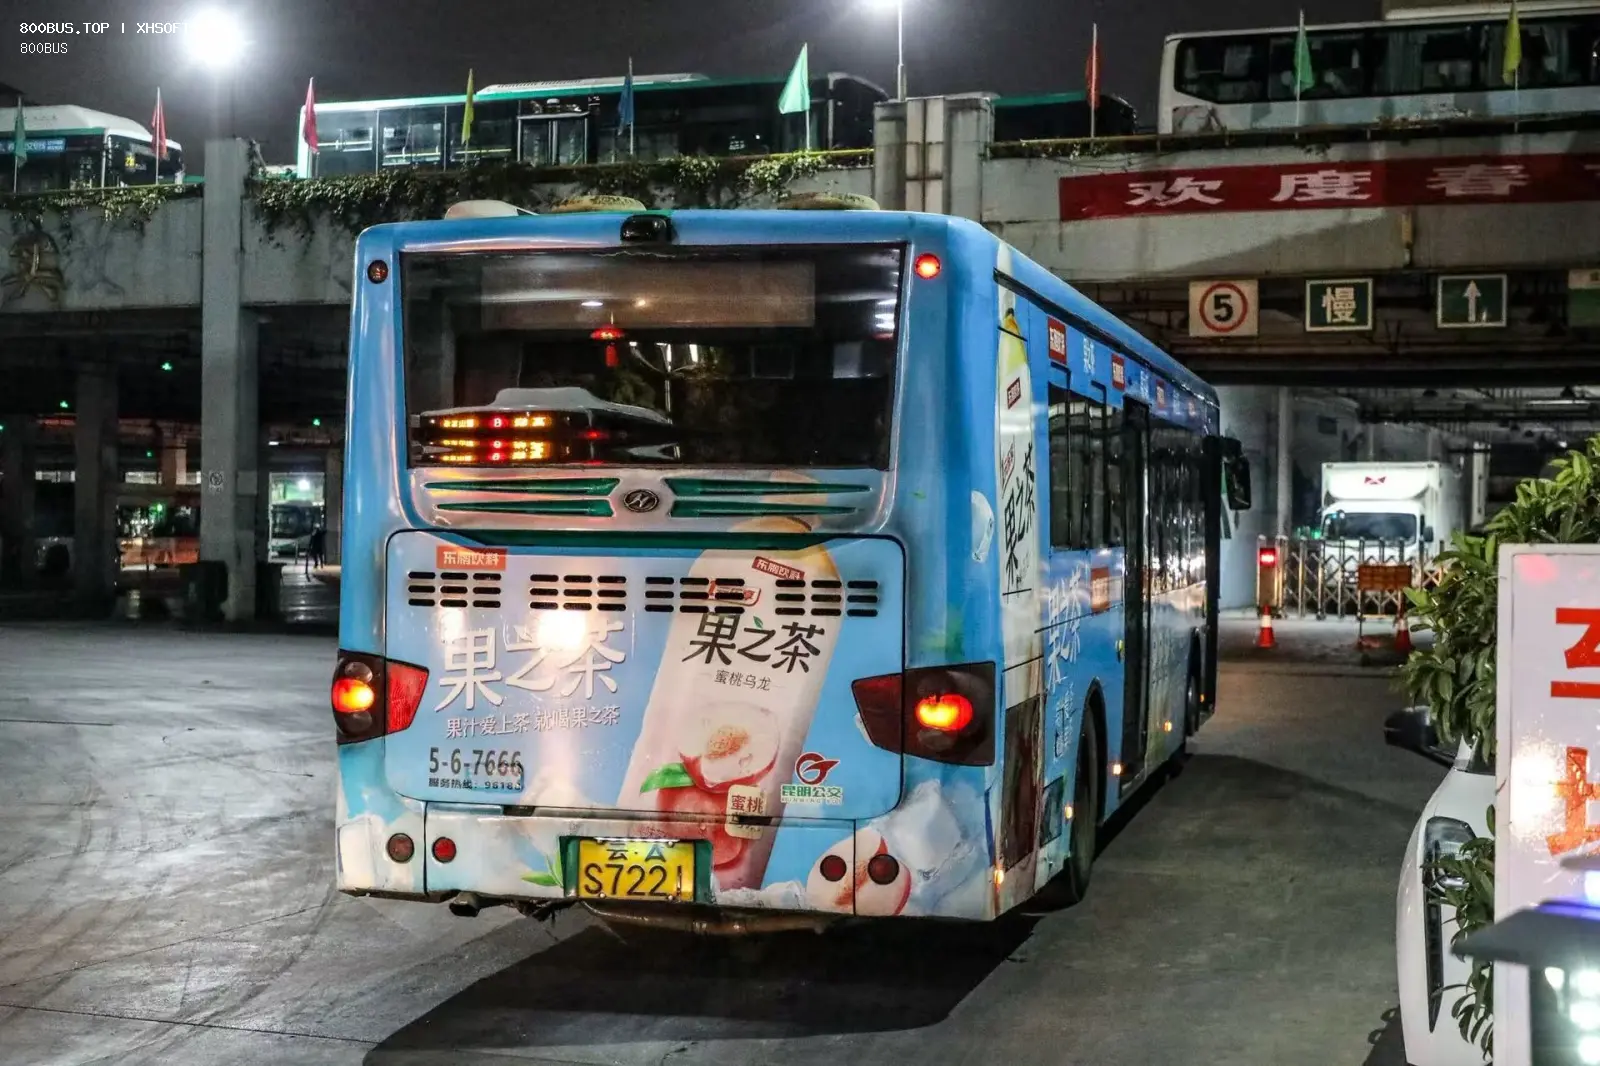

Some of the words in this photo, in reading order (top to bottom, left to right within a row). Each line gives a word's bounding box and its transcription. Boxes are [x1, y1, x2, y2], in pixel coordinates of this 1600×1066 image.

[1125, 163, 1600, 206] 欢度春
[1213, 293, 1234, 322] 5
[1321, 286, 1357, 324] 慢
[681, 611, 826, 674] 果之茶
[433, 618, 627, 713] 果之茶
[713, 668, 771, 692] 蜜桃乌龙
[446, 714, 531, 740] 果汁爱上茶
[533, 705, 621, 733] 就喝果之茶
[429, 746, 524, 777] 5-6-7666
[730, 795, 764, 815] 蜜桃
[782, 785, 841, 798] 昆明公交
[584, 862, 683, 897] S7221
